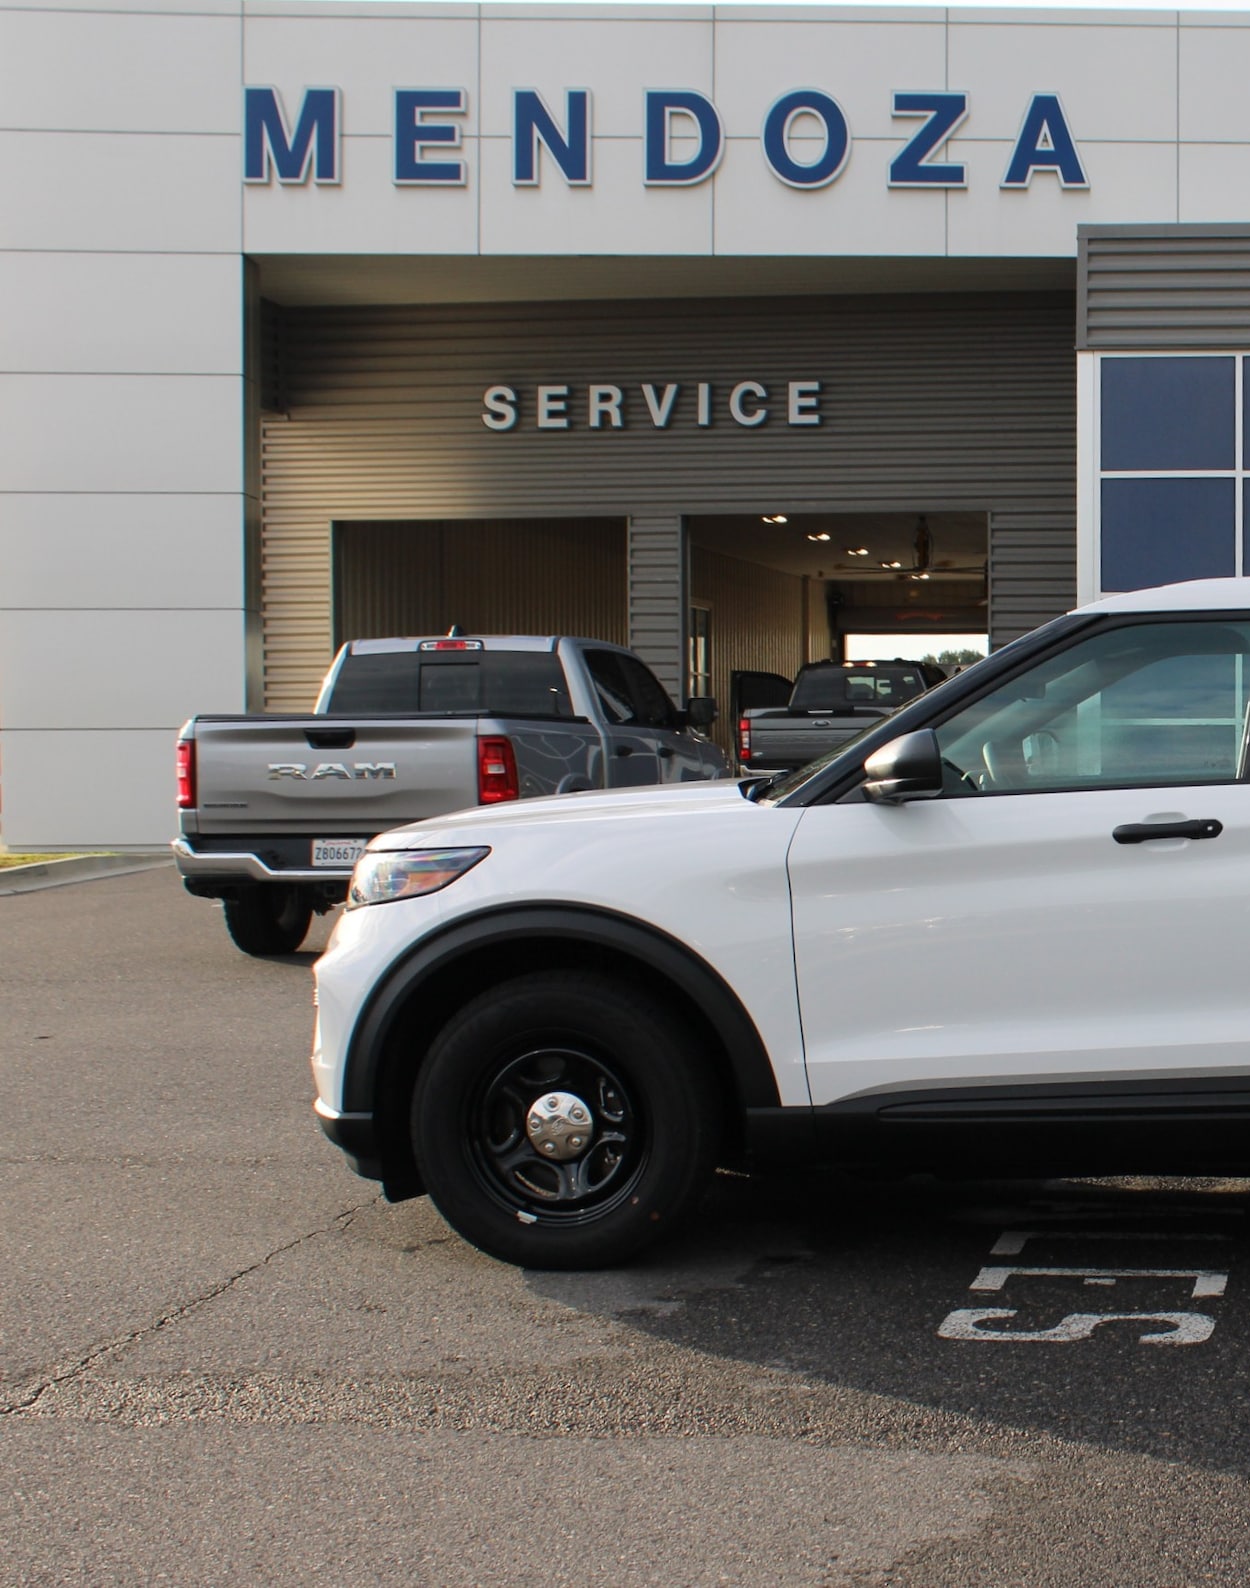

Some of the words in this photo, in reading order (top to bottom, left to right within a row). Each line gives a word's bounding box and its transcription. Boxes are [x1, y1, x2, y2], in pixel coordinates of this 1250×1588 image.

[242, 86, 1090, 190] MENDOZA
[482, 380, 823, 430] SERVICE
[267, 762, 397, 780] RAM
